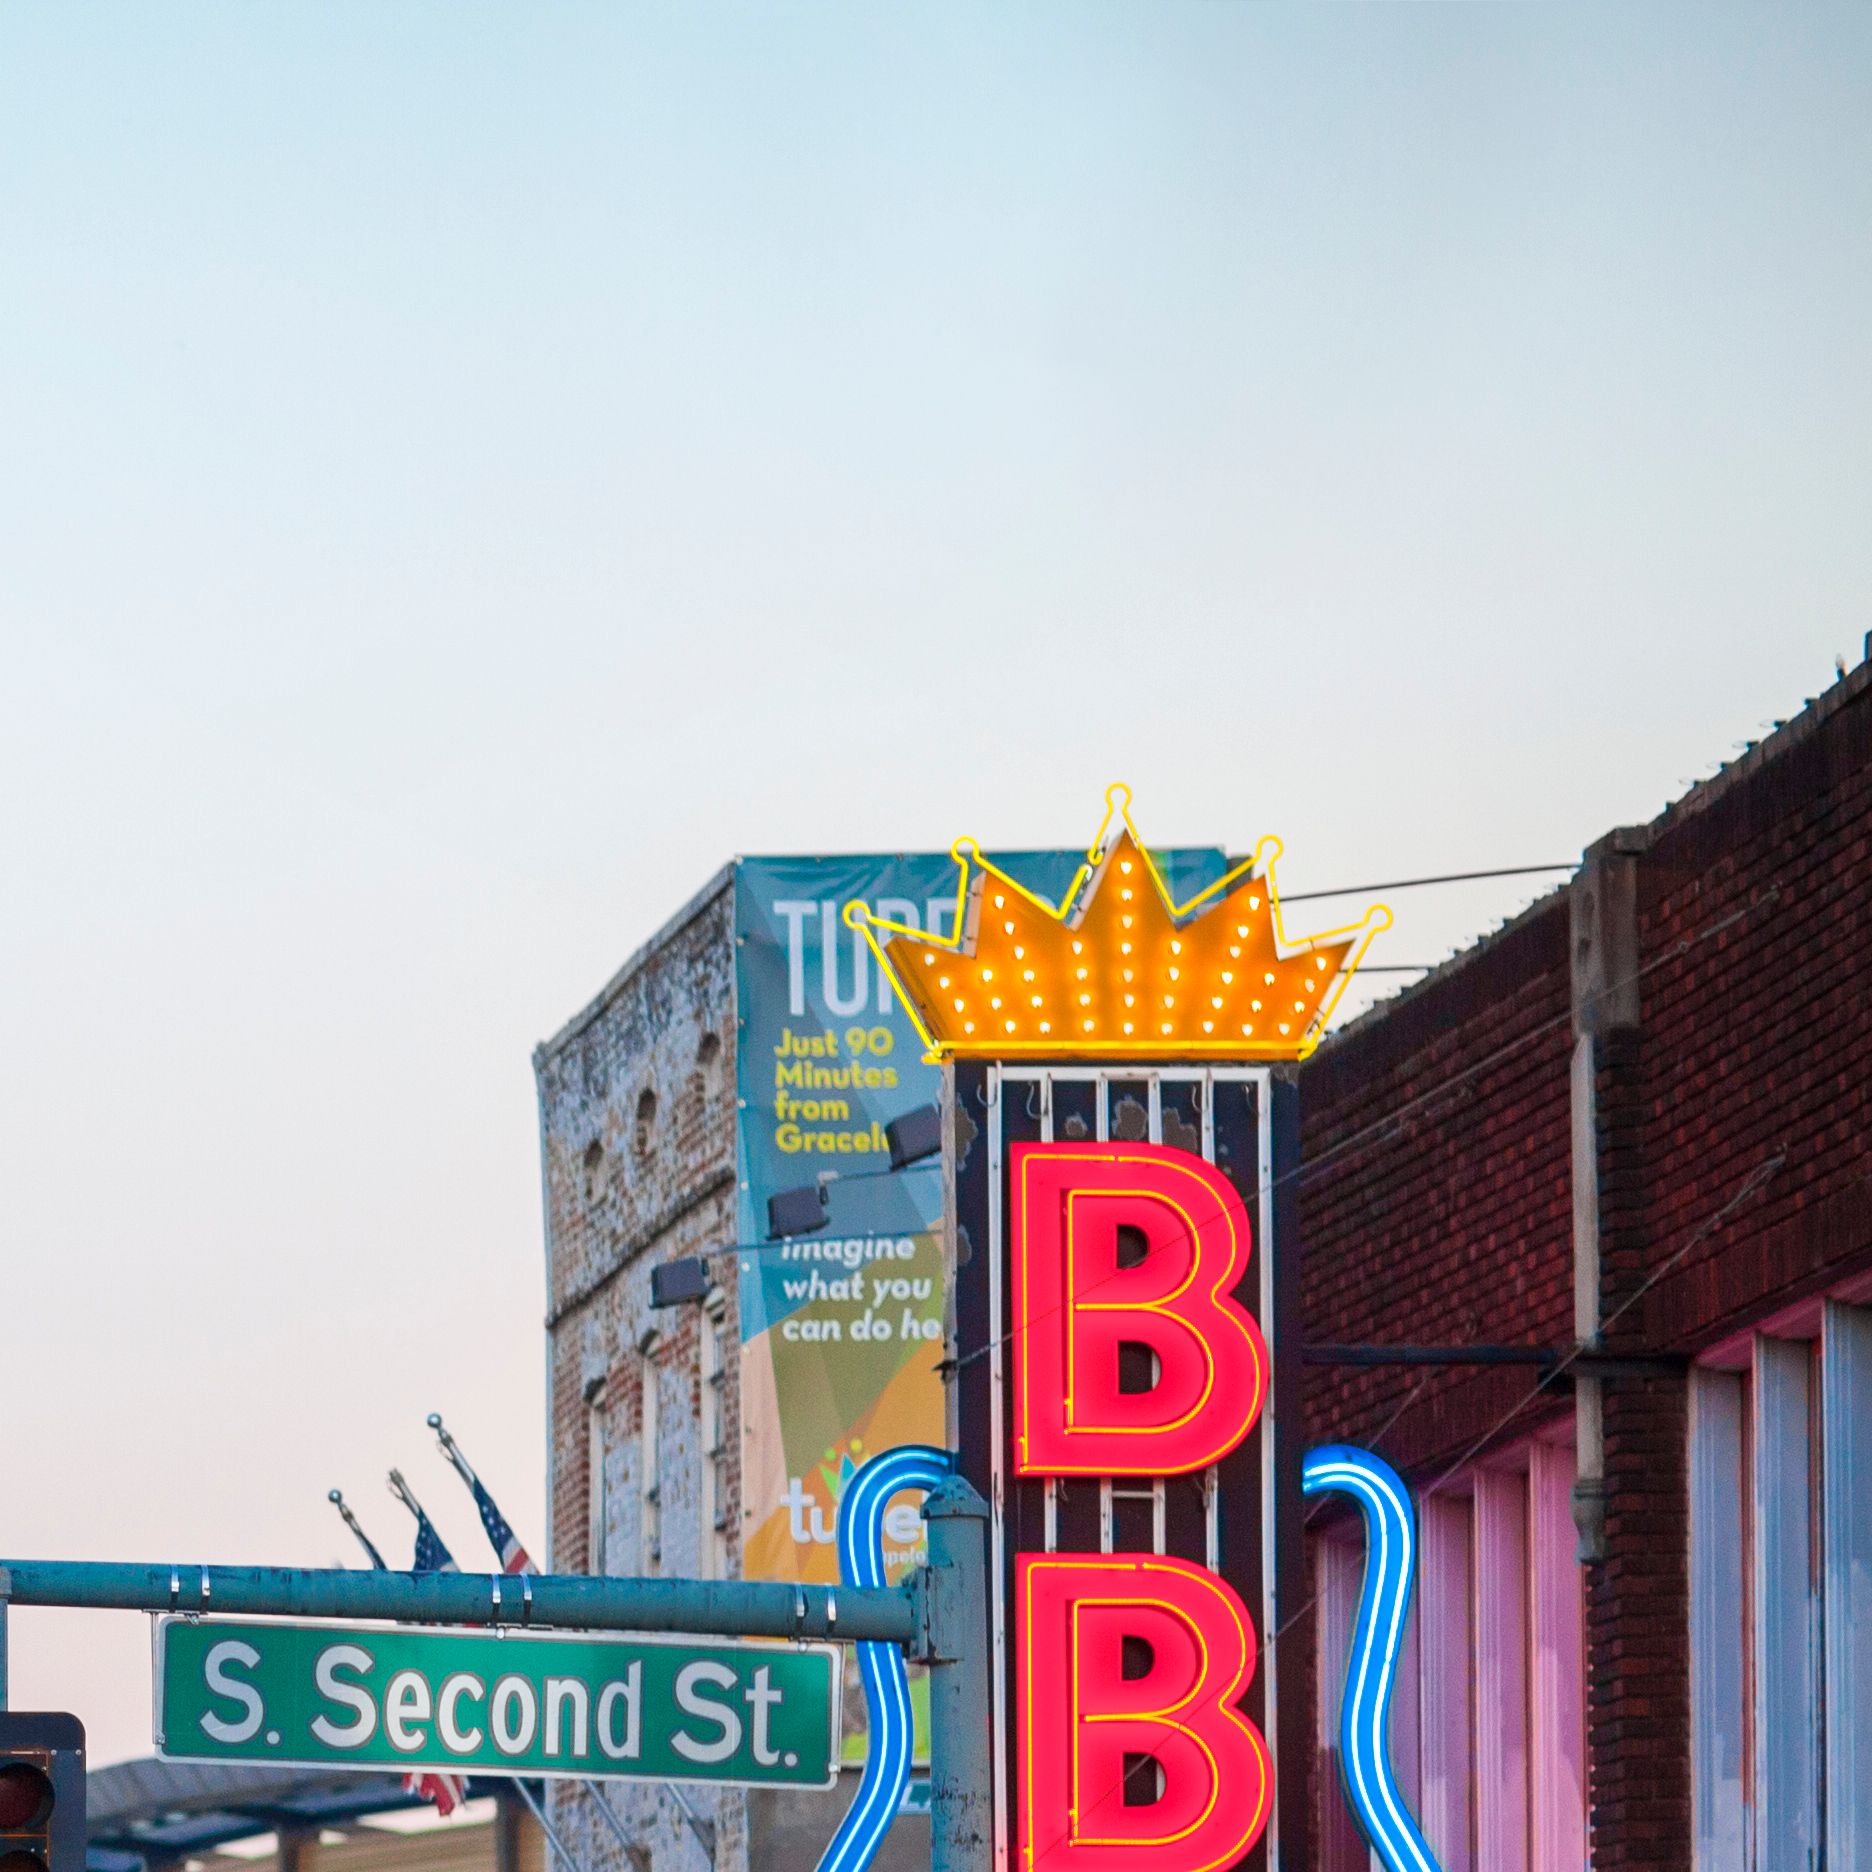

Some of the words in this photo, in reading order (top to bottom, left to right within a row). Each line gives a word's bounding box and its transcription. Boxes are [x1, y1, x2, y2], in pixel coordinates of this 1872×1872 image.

[774, 1027, 837, 1058] Just
[846, 1027, 895, 1055] 90
[774, 1061, 899, 1090] Minutes
[774, 1090, 849, 1121] from
[775, 1121, 890, 1153] Gracel
[781, 1234, 916, 1272] imagine
[783, 1272, 864, 1301] what
[872, 1278, 933, 1308] you
[782, 1316, 842, 1342] can
[850, 1309, 894, 1342] do
[1010, 1141, 1269, 1477] B
[199, 1639, 281, 1746] S.
[309, 1643, 643, 1761] Second
[669, 1660, 801, 1769] St.
